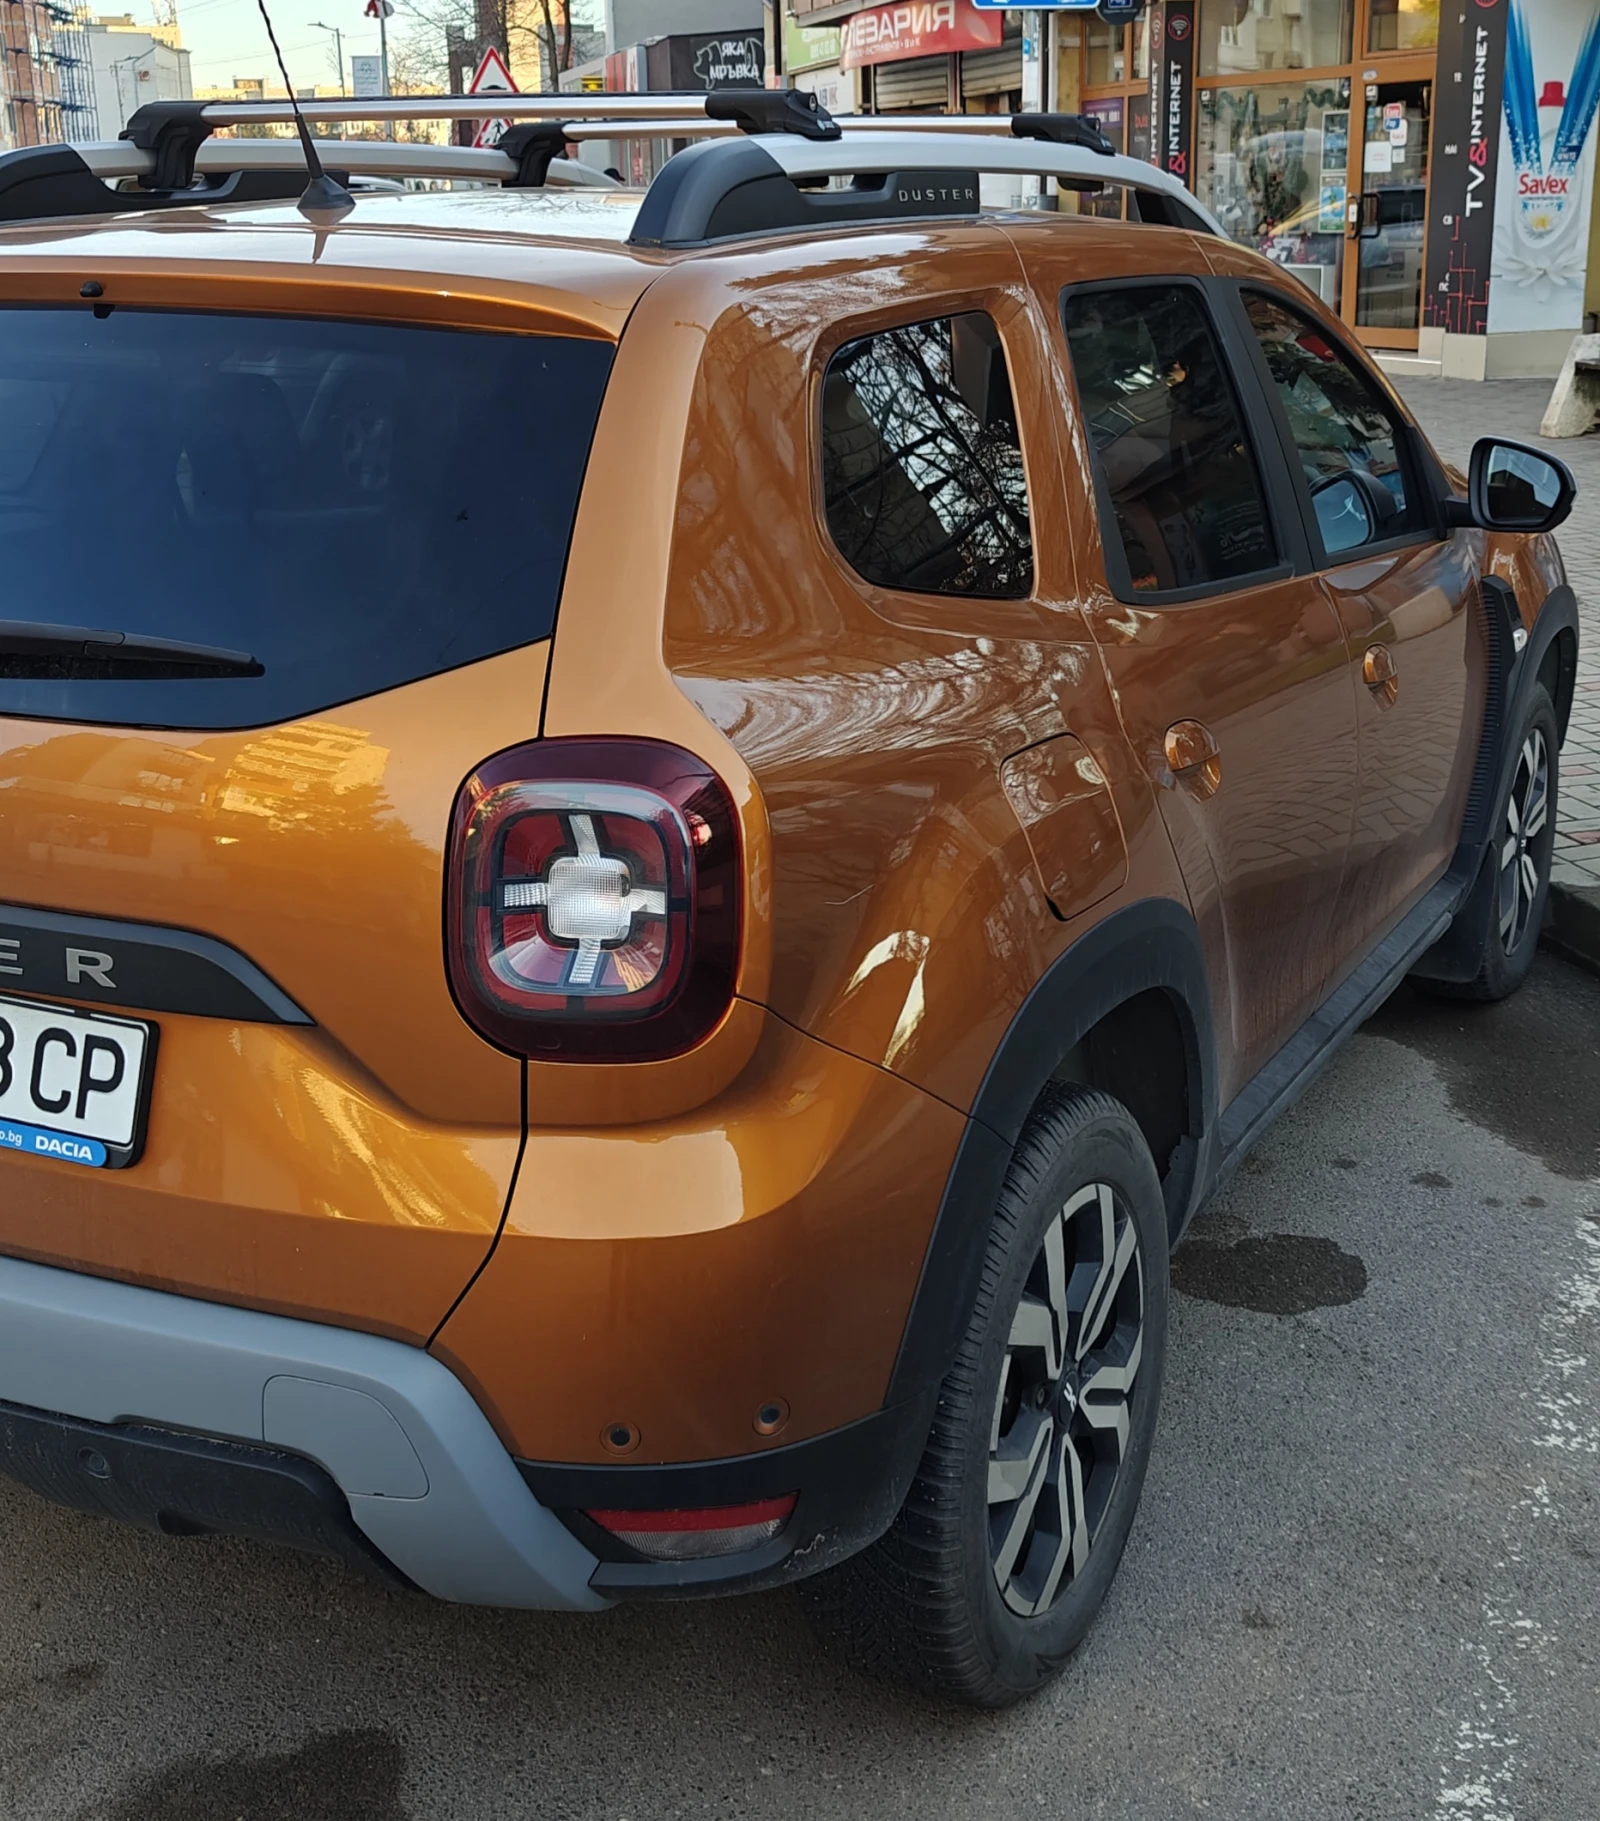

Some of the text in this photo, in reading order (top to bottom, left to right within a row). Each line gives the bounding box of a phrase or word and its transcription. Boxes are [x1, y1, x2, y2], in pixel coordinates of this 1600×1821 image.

[722, 41, 745, 57] ЯКА
[709, 64, 759, 80] МРЪВКА
[898, 188, 974, 202] DUSTER
[35, 1135, 93, 1161] DACIA
